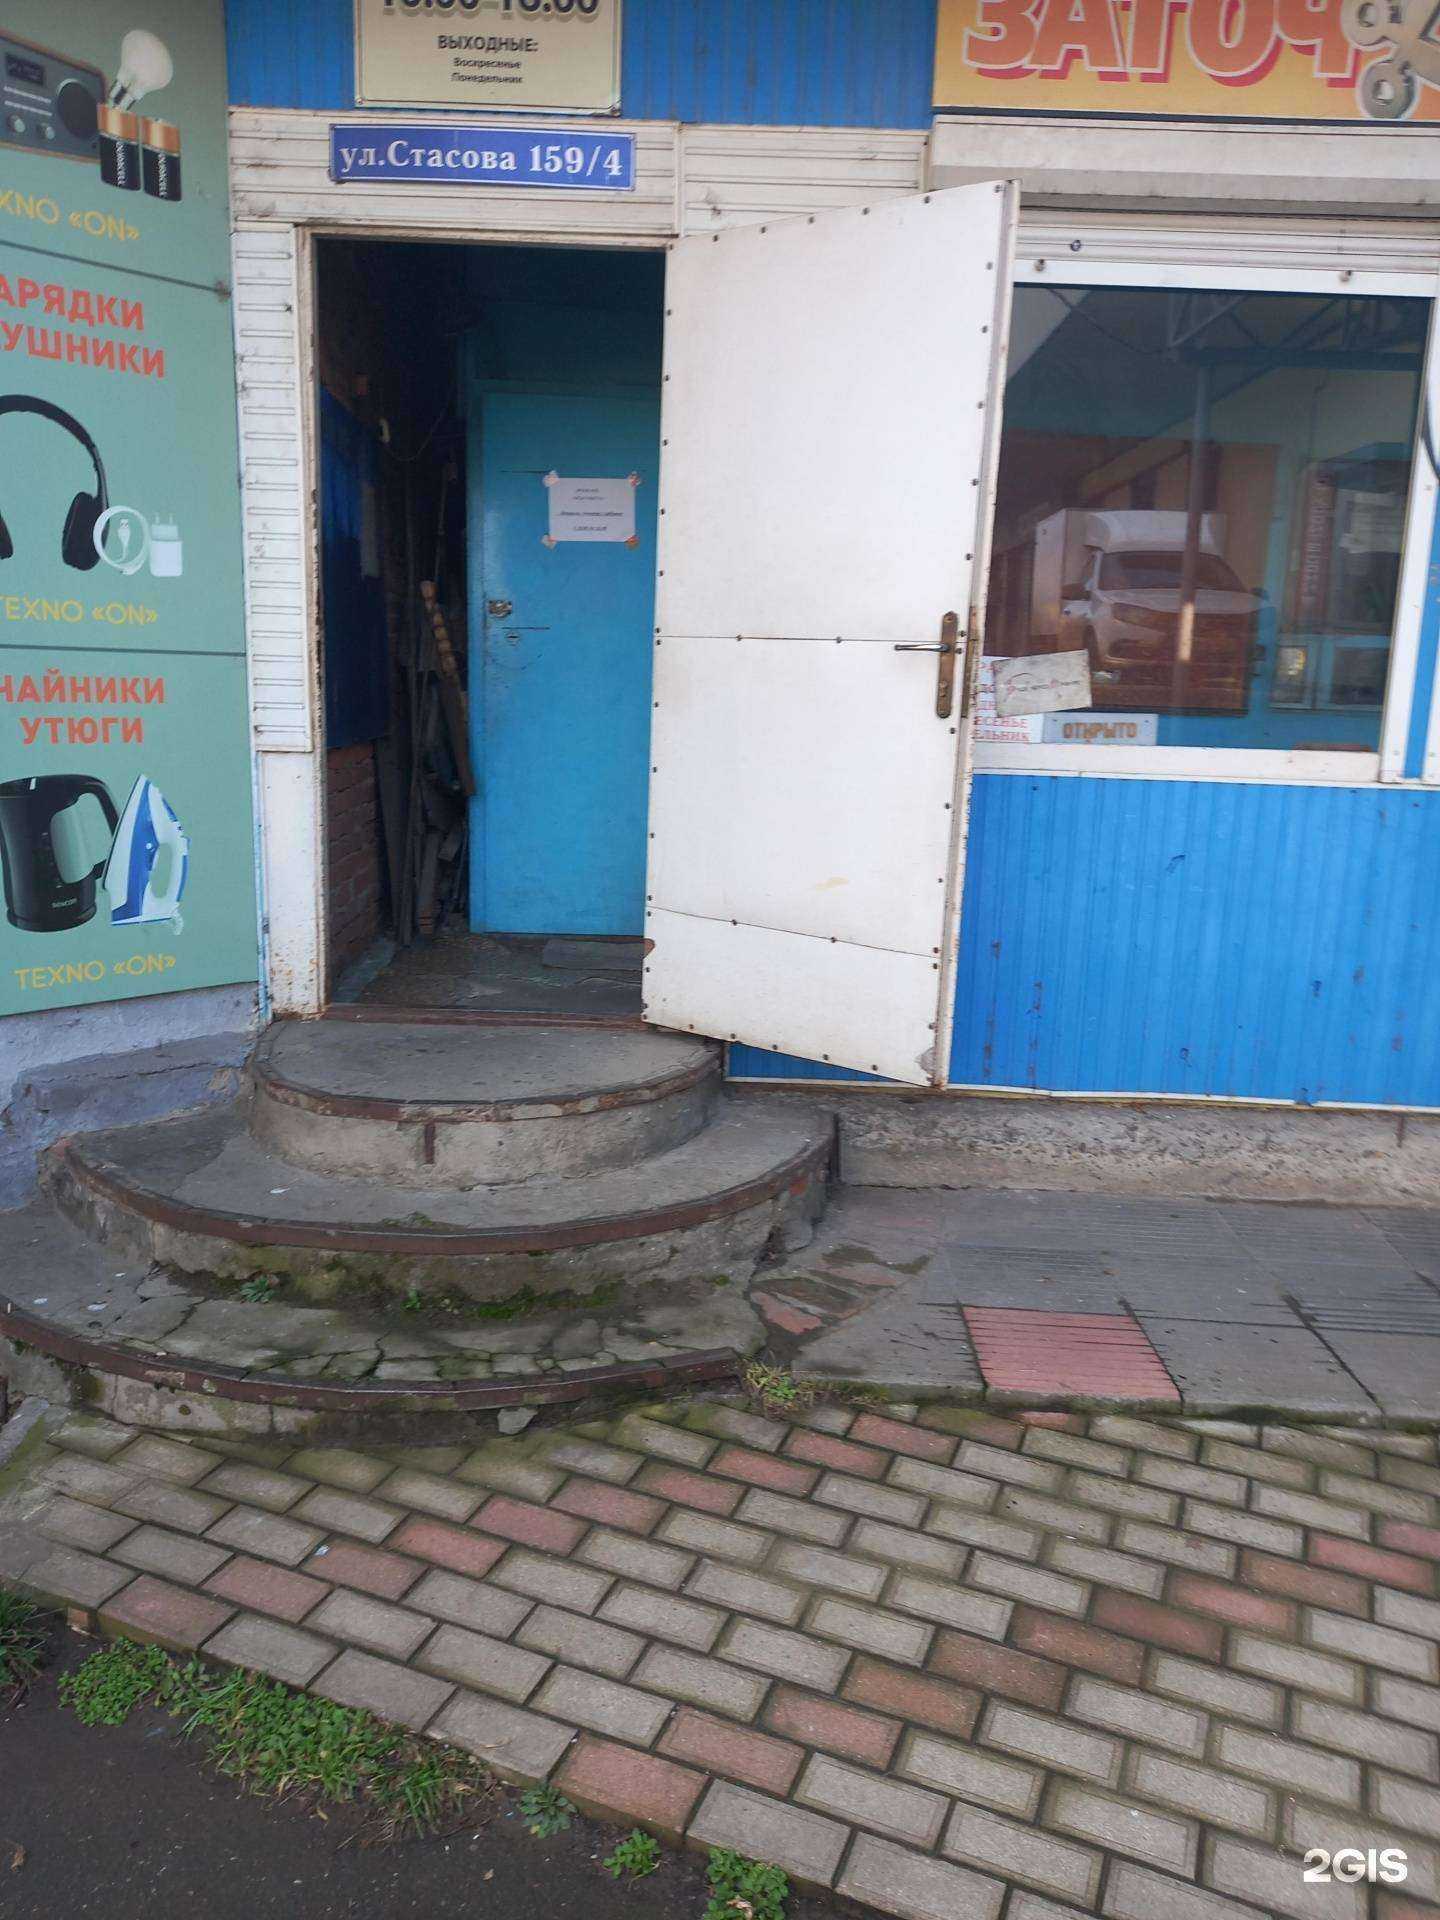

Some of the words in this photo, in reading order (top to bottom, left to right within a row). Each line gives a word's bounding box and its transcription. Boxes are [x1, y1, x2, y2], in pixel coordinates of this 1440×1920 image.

[437, 35, 539, 53] ВЫХОДНЫЕ:
[453, 57, 522, 69] Воскресенье
[451, 72, 523, 84] Понедельник
[339, 140, 518, 173] ул.Стасова
[529, 145, 624, 177] 159/4
[19, 716, 144, 745] УТЮГИ
[1062, 721, 1138, 743] ОТКРЫТО
[15, 960, 106, 991] TEXNO
